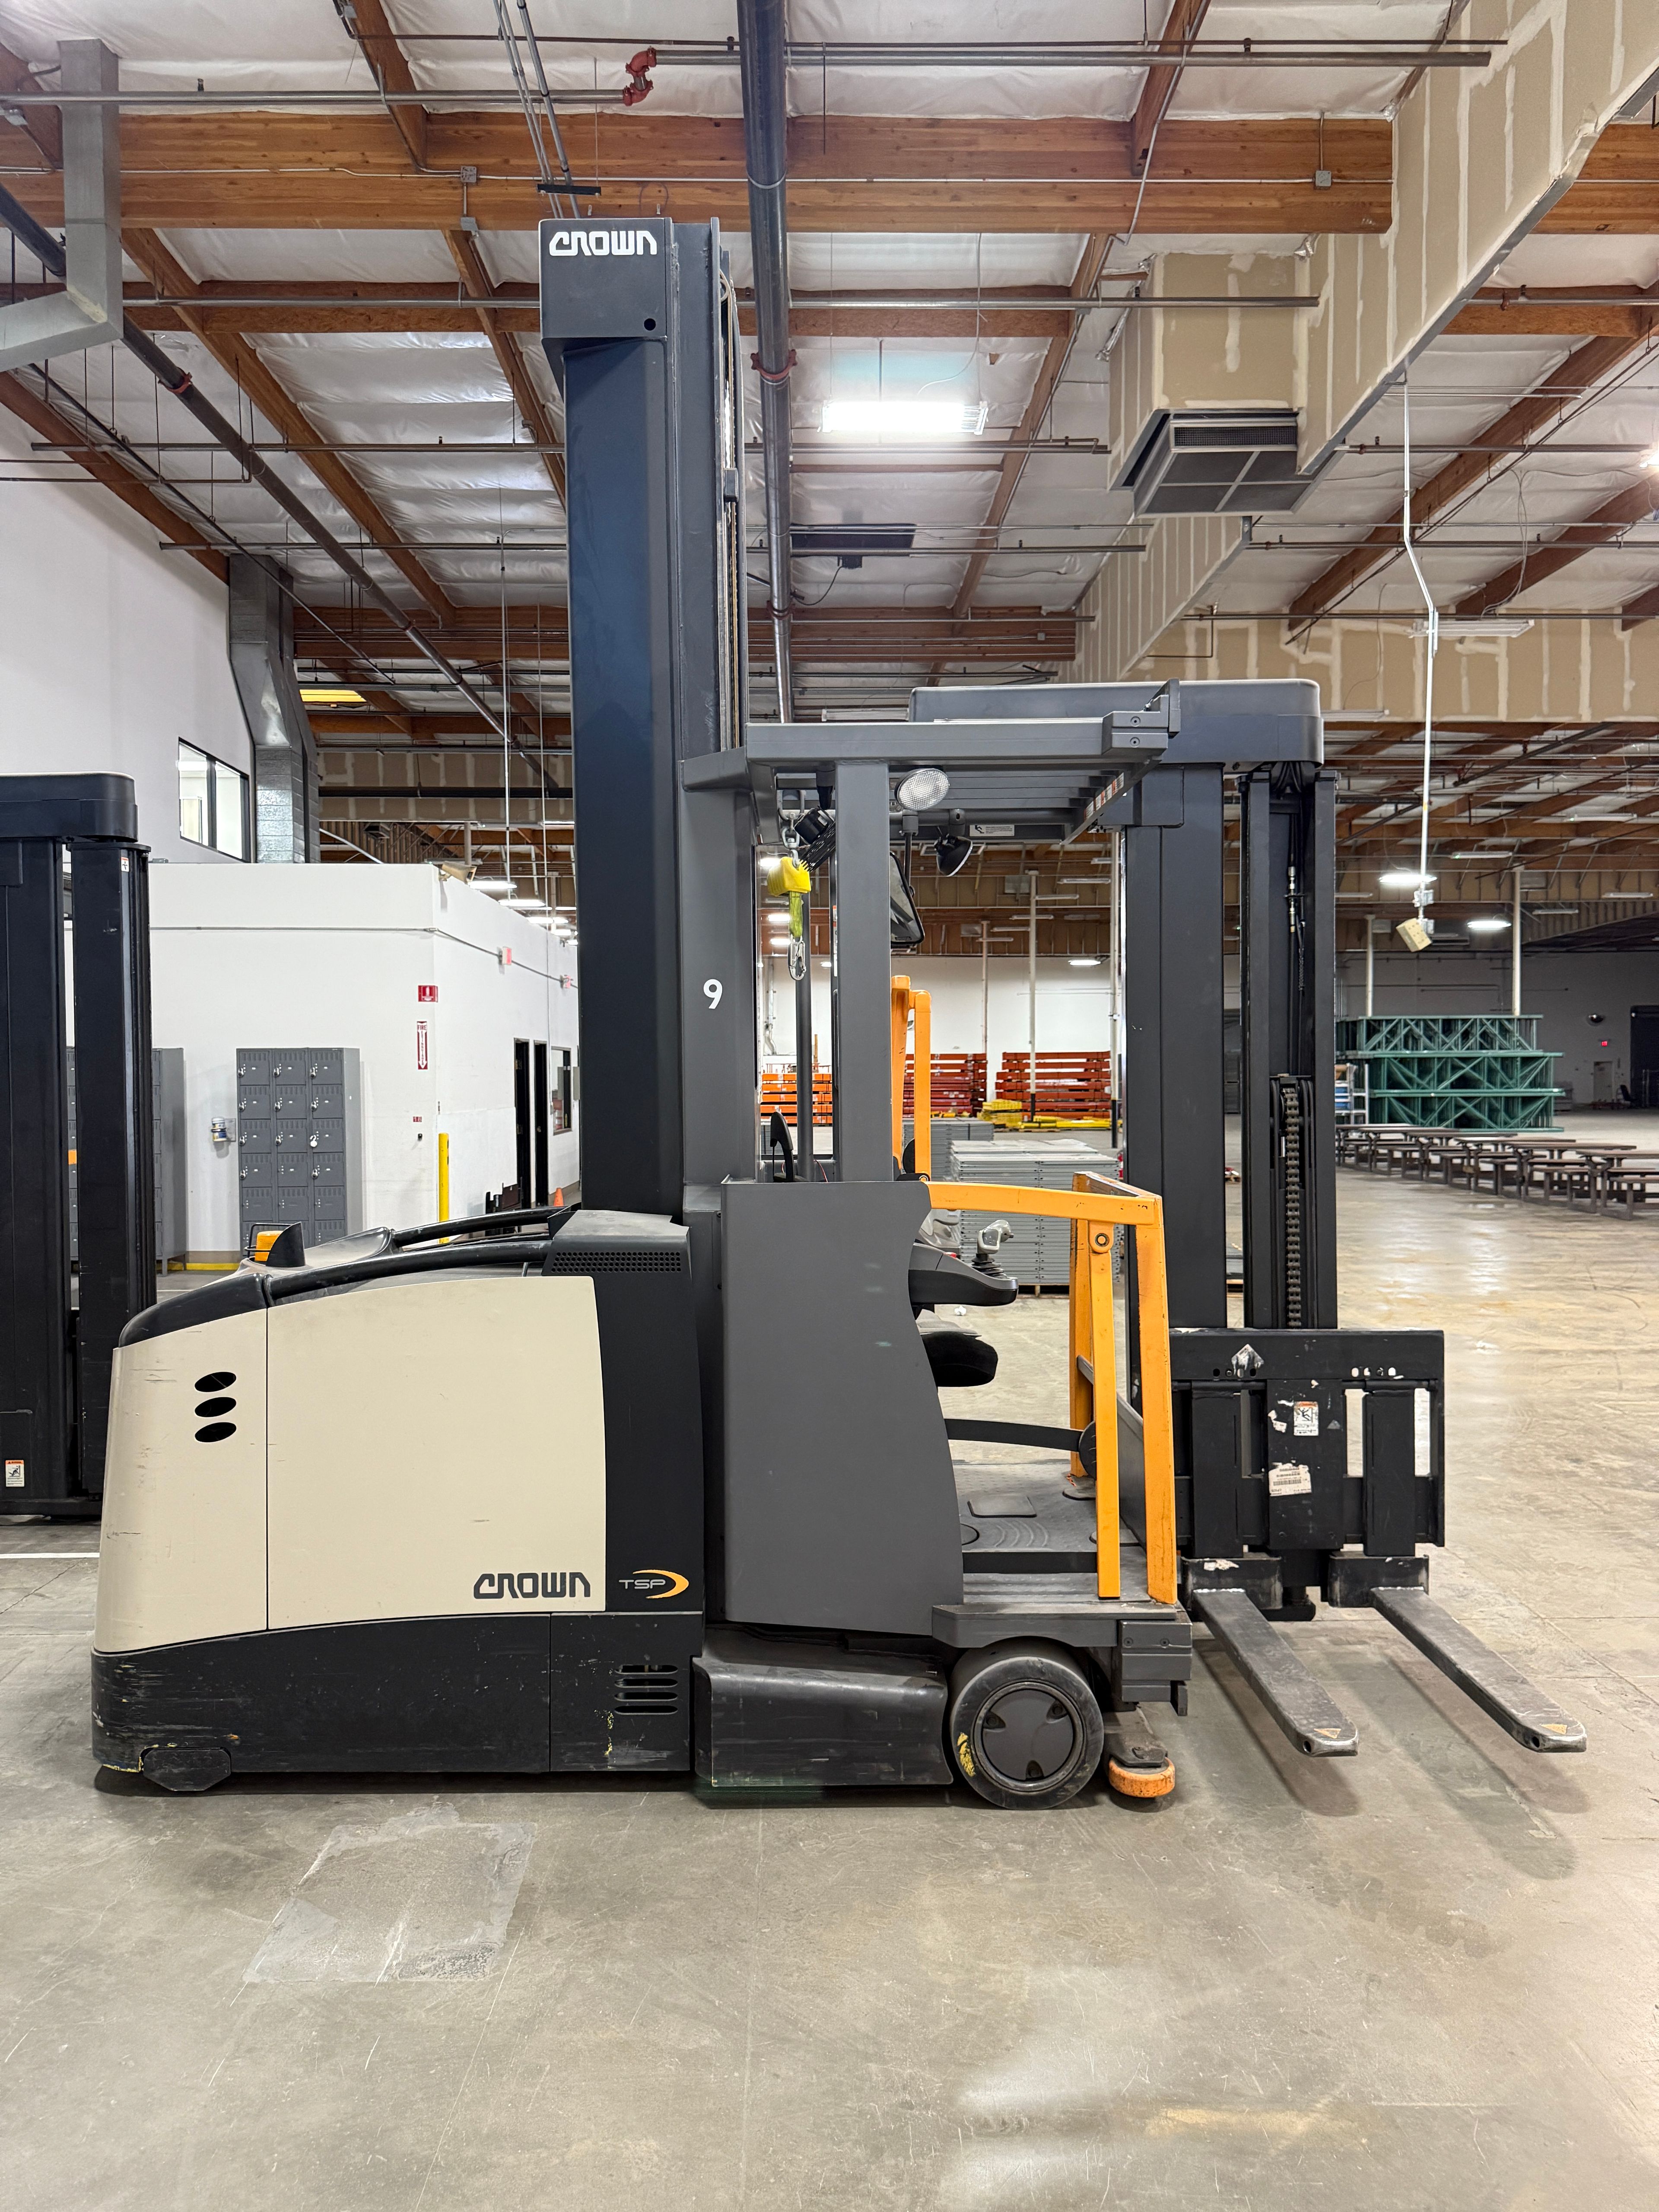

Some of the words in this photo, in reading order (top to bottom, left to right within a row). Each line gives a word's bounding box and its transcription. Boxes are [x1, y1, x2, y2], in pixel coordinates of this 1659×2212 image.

[549, 230, 657, 256] CROWN
[703, 979, 723, 1009] 9
[474, 1572, 591, 1599] CROWN
[618, 1579, 667, 1590] TSP
